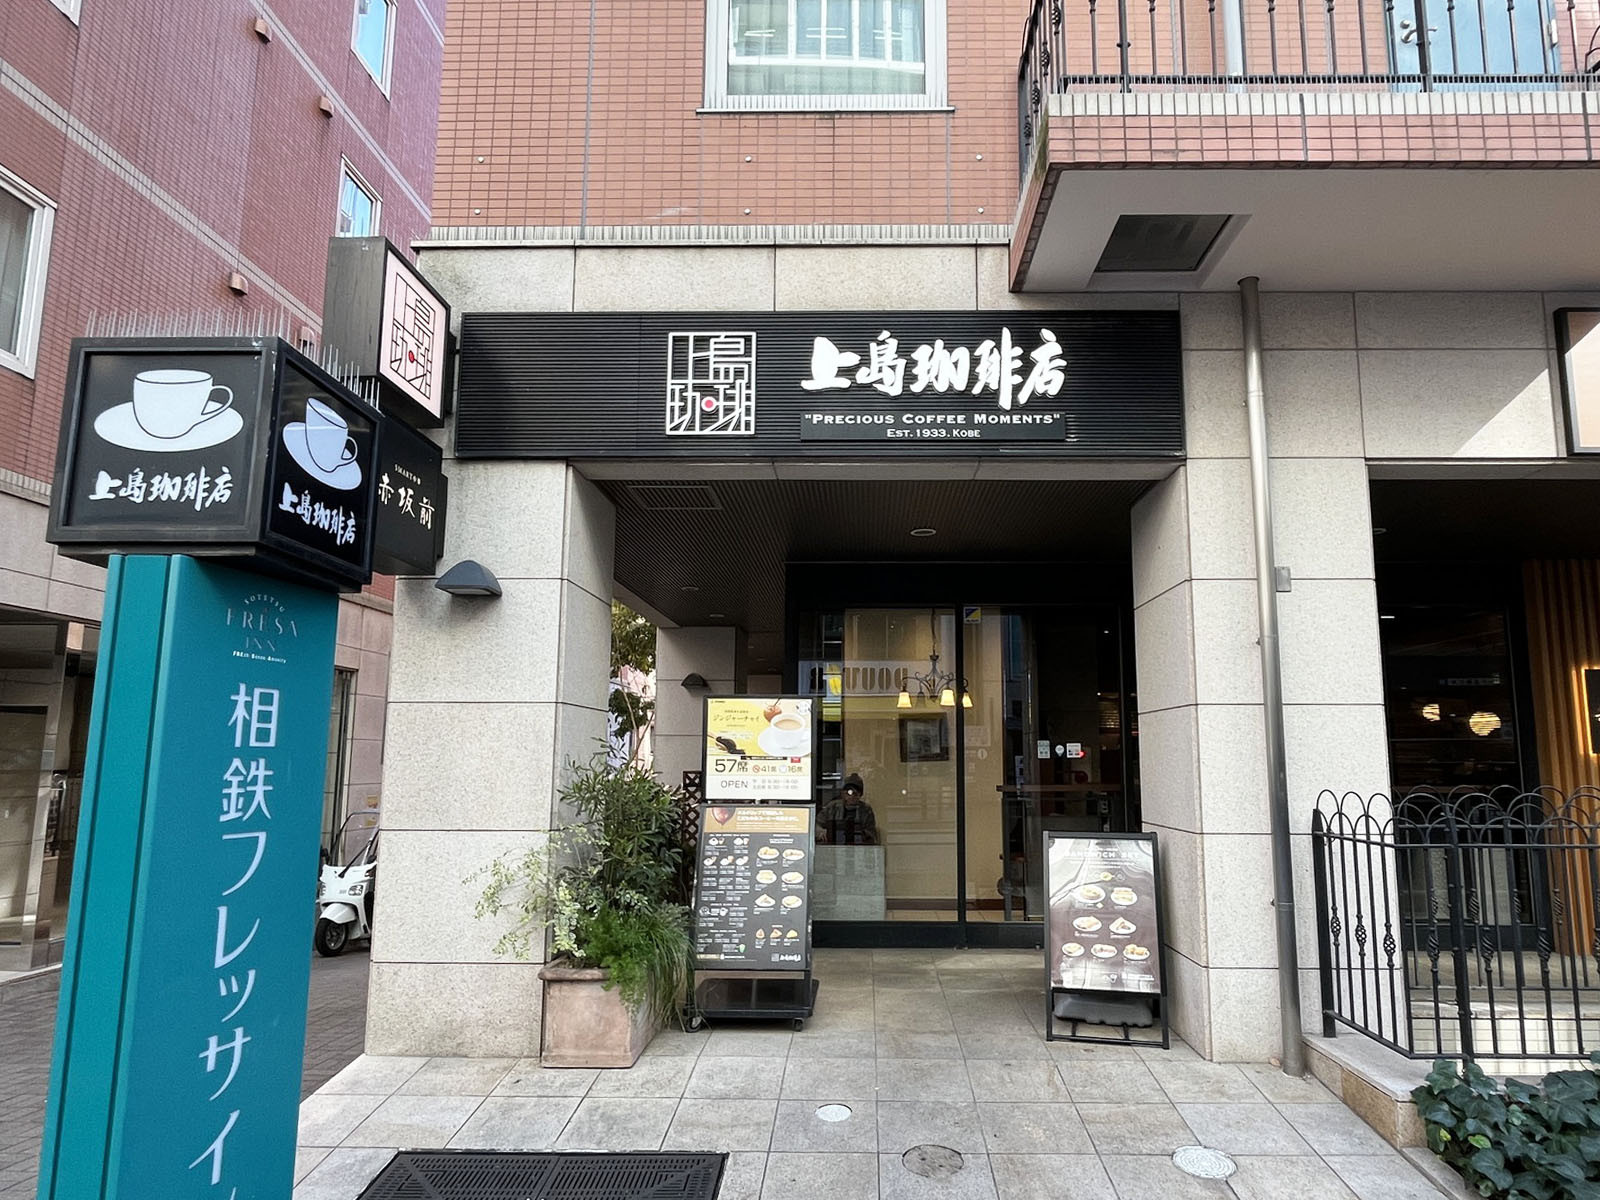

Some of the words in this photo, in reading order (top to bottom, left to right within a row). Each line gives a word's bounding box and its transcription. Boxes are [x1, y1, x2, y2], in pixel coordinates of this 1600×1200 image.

[801, 325, 1068, 411] 上島珈琲店
[901, 414, 967, 425] COFFEE
[88, 466, 234, 512] 上島珈琲店
[278, 481, 357, 547] 上島珈琲店
[378, 471, 437, 531] 赤坂前
[721, 780, 749, 789] OPEN
[188, 682, 280, 1200] 相鉄フレッサイ
